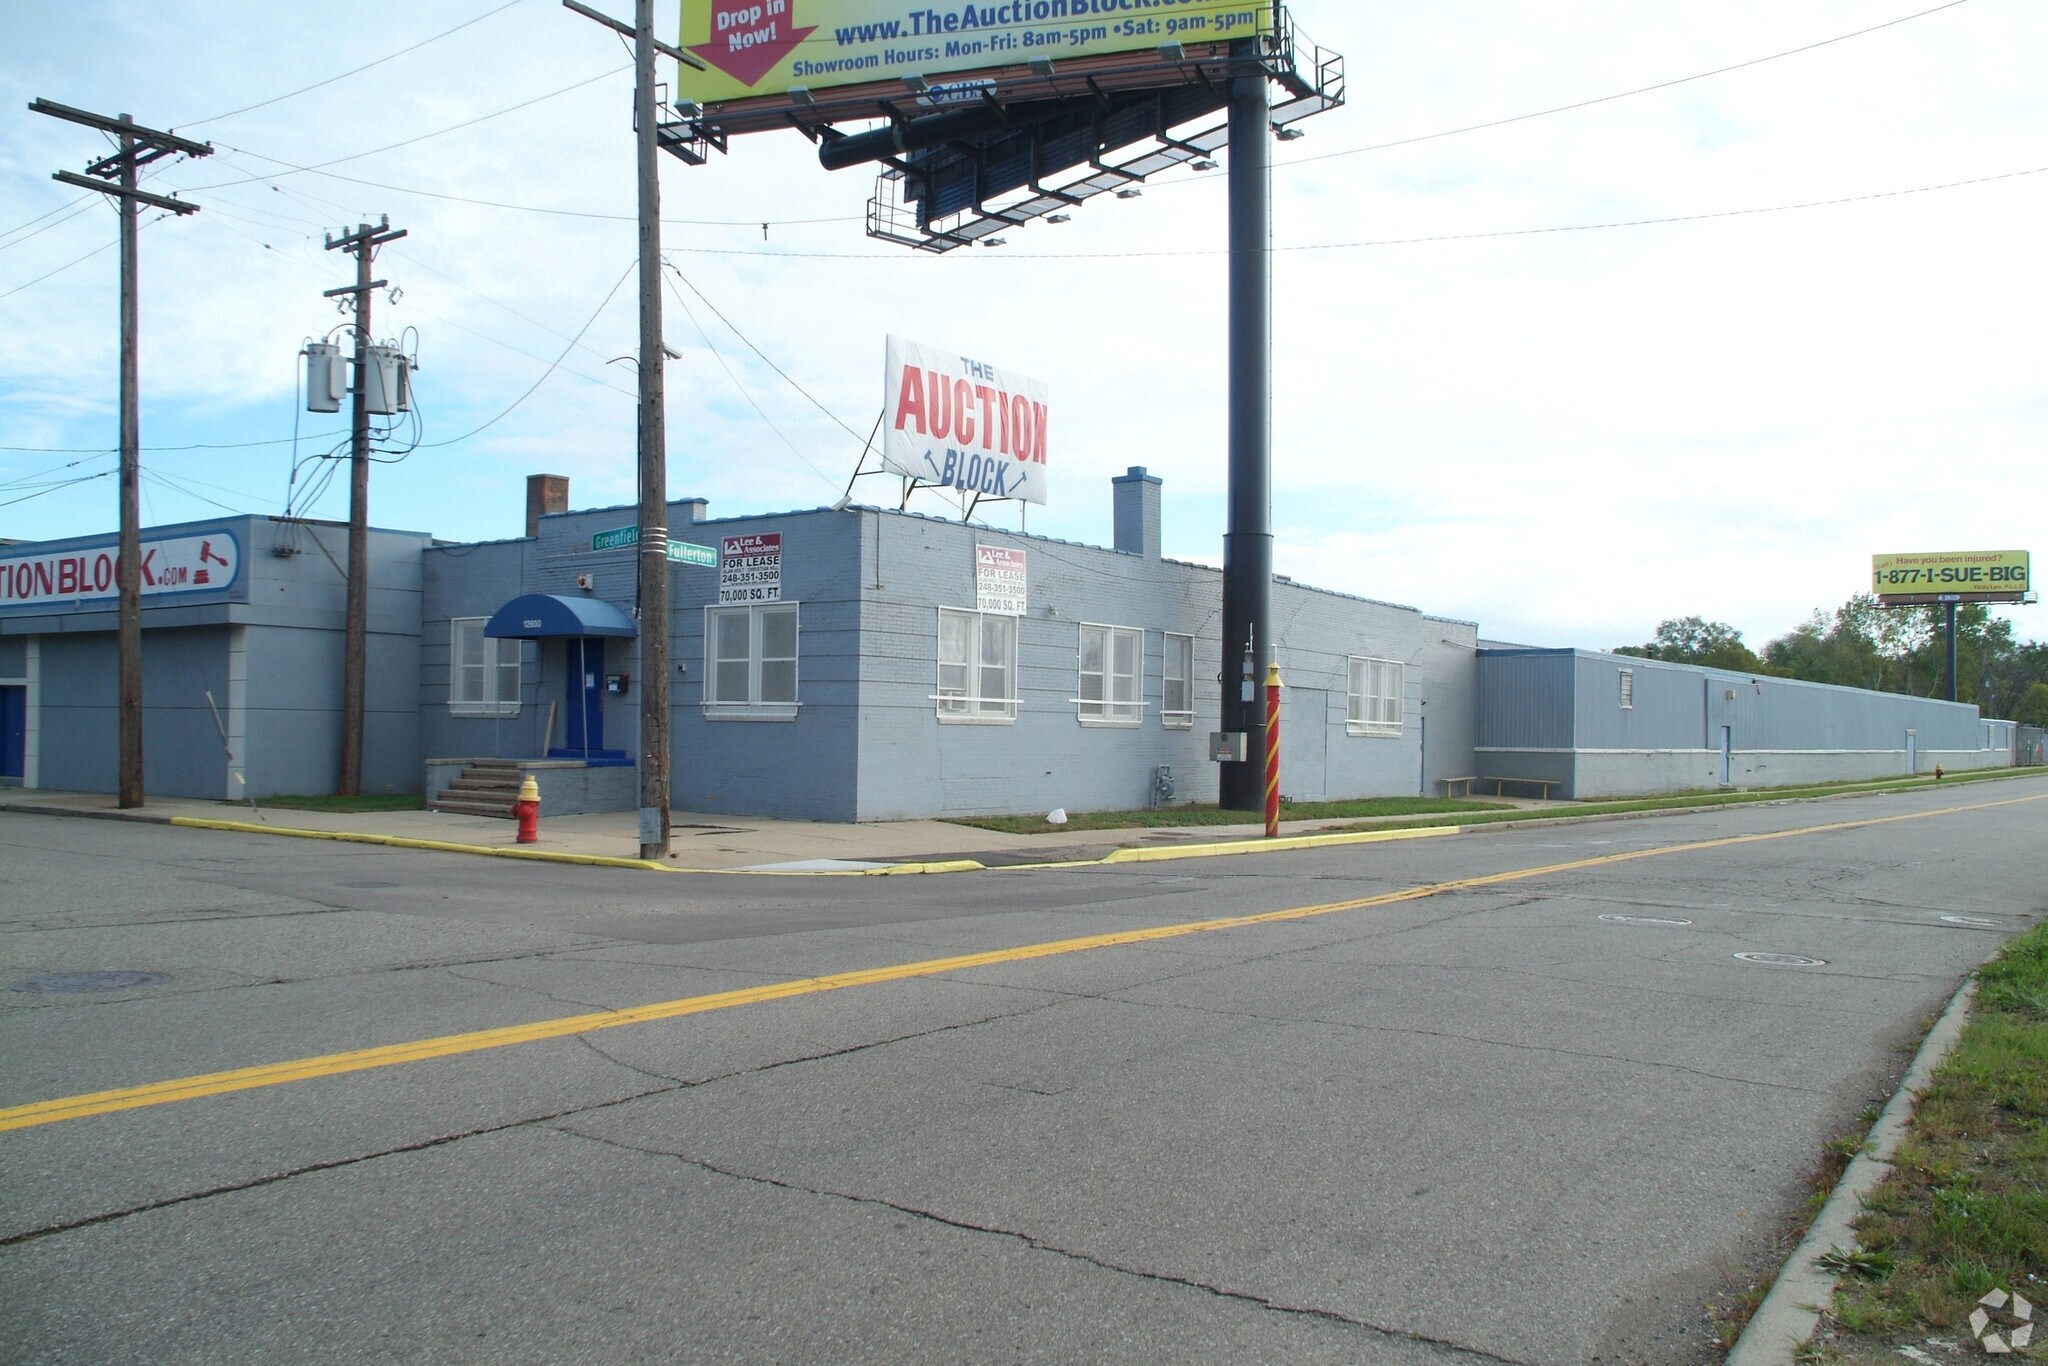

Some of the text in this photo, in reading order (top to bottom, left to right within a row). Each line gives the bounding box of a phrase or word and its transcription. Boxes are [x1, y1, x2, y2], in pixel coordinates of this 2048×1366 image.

[717, 0, 785, 31] Drop in
[728, 21, 777, 52] Now!
[793, 53, 879, 77] Showroom
[884, 47, 939, 66] Hours:
[945, 33, 1017, 57] Mon-Fri:
[1022, 24, 1107, 47] 8am-5pm
[1166, 12, 1254, 35] 9am-5pm
[960, 356, 995, 382] THE
[895, 364, 1048, 465] AUCTION
[941, 448, 1010, 497] BLOCK
[740, 536, 763, 546] Lee &
[668, 543, 713, 563] Fullerton
[1896, 554, 2003, 566] Have you been injured?
[723, 556, 780, 568] FOR LEASE
[722, 571, 780, 583] 248-351-3500
[978, 569, 1025, 581] FOR LEASE
[1874, 566, 2026, 584] 1-877-I-SUE-BIG
[720, 587, 780, 602] 70,000 SQ. FT.
[978, 582, 1025, 595] 248-351-3500
[978, 598, 1001, 611] 70,000
[1002, 600, 1015, 611] SQ.
